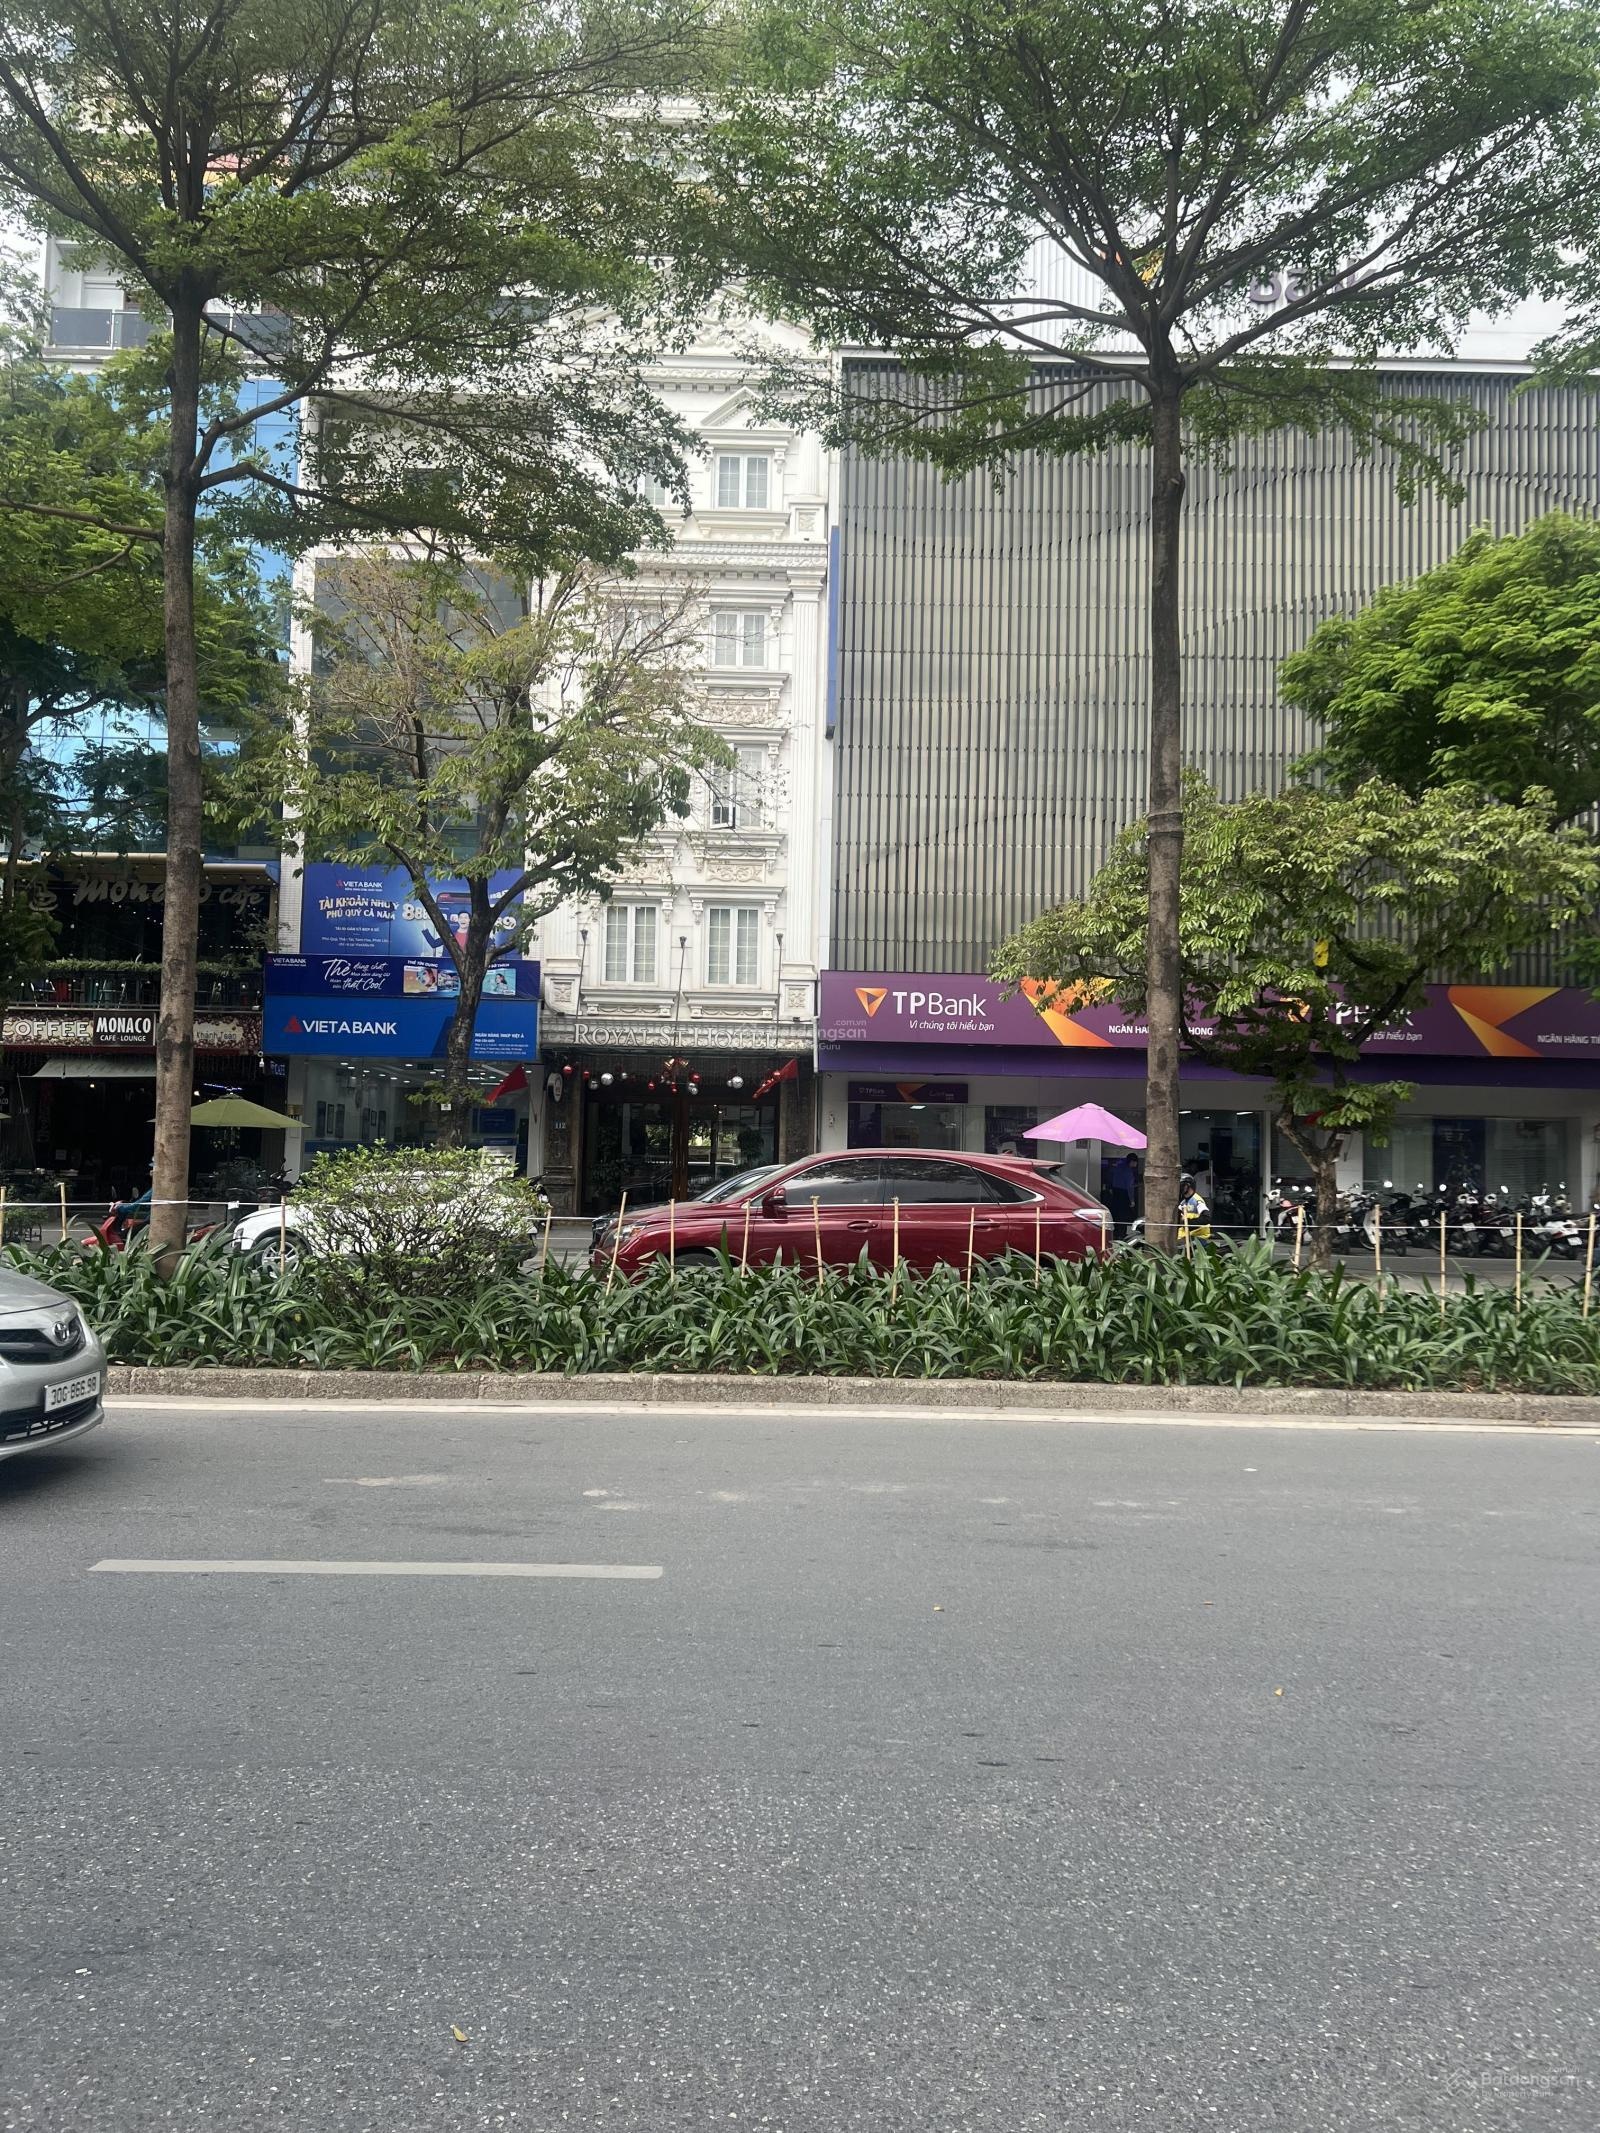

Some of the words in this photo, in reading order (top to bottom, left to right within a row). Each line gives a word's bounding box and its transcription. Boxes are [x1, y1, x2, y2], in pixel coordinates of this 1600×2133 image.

[892, 991, 987, 1017] TPBank
[2, 1021, 90, 1037] COFFEE
[96, 1017, 151, 1033] MONACO
[302, 1020, 397, 1035] VIETABANK
[909, 1020, 918, 1029] Vì
[919, 1020, 944, 1032] chúng
[947, 1021, 957, 1030] tôi
[959, 1019, 978, 1031] hiểu
[978, 1022, 994, 1032] bạn
[1187, 1027, 1213, 1036] HONG
[573, 1023, 654, 1046] ROYAL
[693, 1027, 778, 1049] HOTEL
